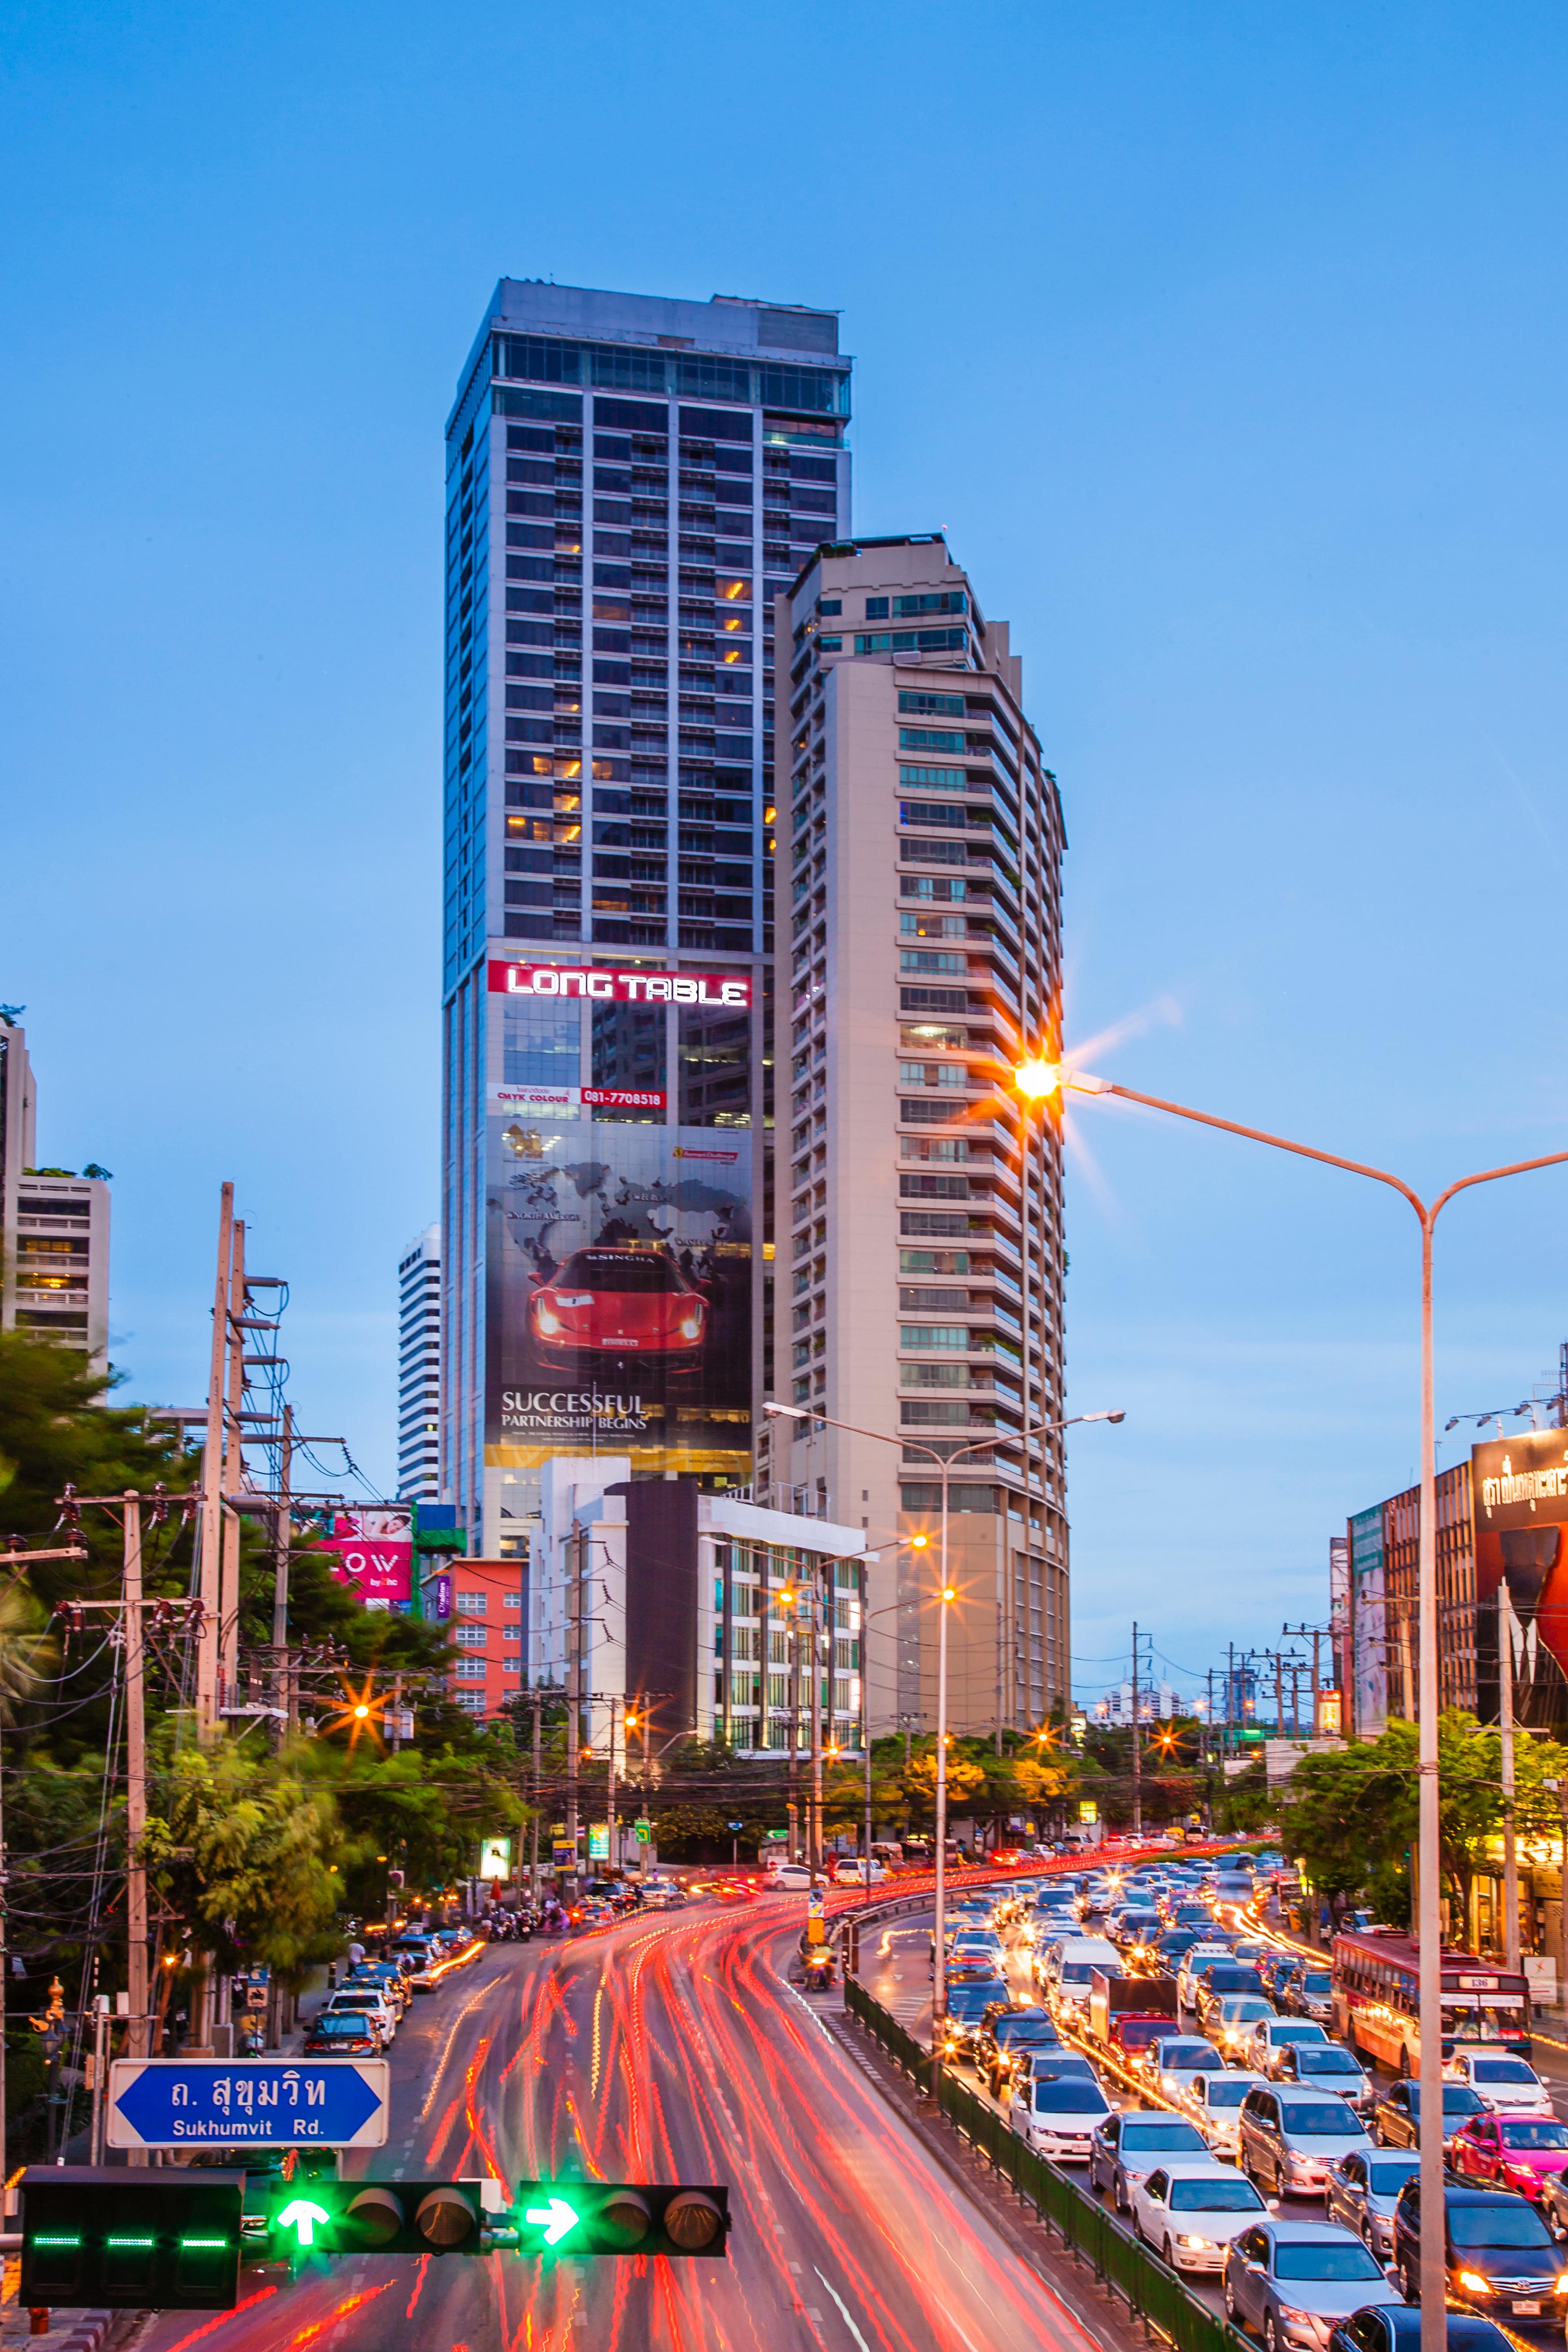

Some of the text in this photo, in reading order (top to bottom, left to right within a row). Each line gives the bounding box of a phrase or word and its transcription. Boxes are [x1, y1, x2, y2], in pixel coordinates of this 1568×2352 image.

[508, 969, 747, 1006] LONG TABLE
[497, 1092, 568, 1103] CMYK COLOUR
[584, 1090, 661, 1105] 081-7708518
[502, 1392, 647, 1414] SUCCESSFUL
[502, 1415, 647, 1430] PARTNERSHIP BEGINS
[1471, 1979, 1488, 1987] 136
[172, 2070, 326, 2116] ถ. สุขุมวิท
[172, 2118, 324, 2136] Sukhumvit Rd.
